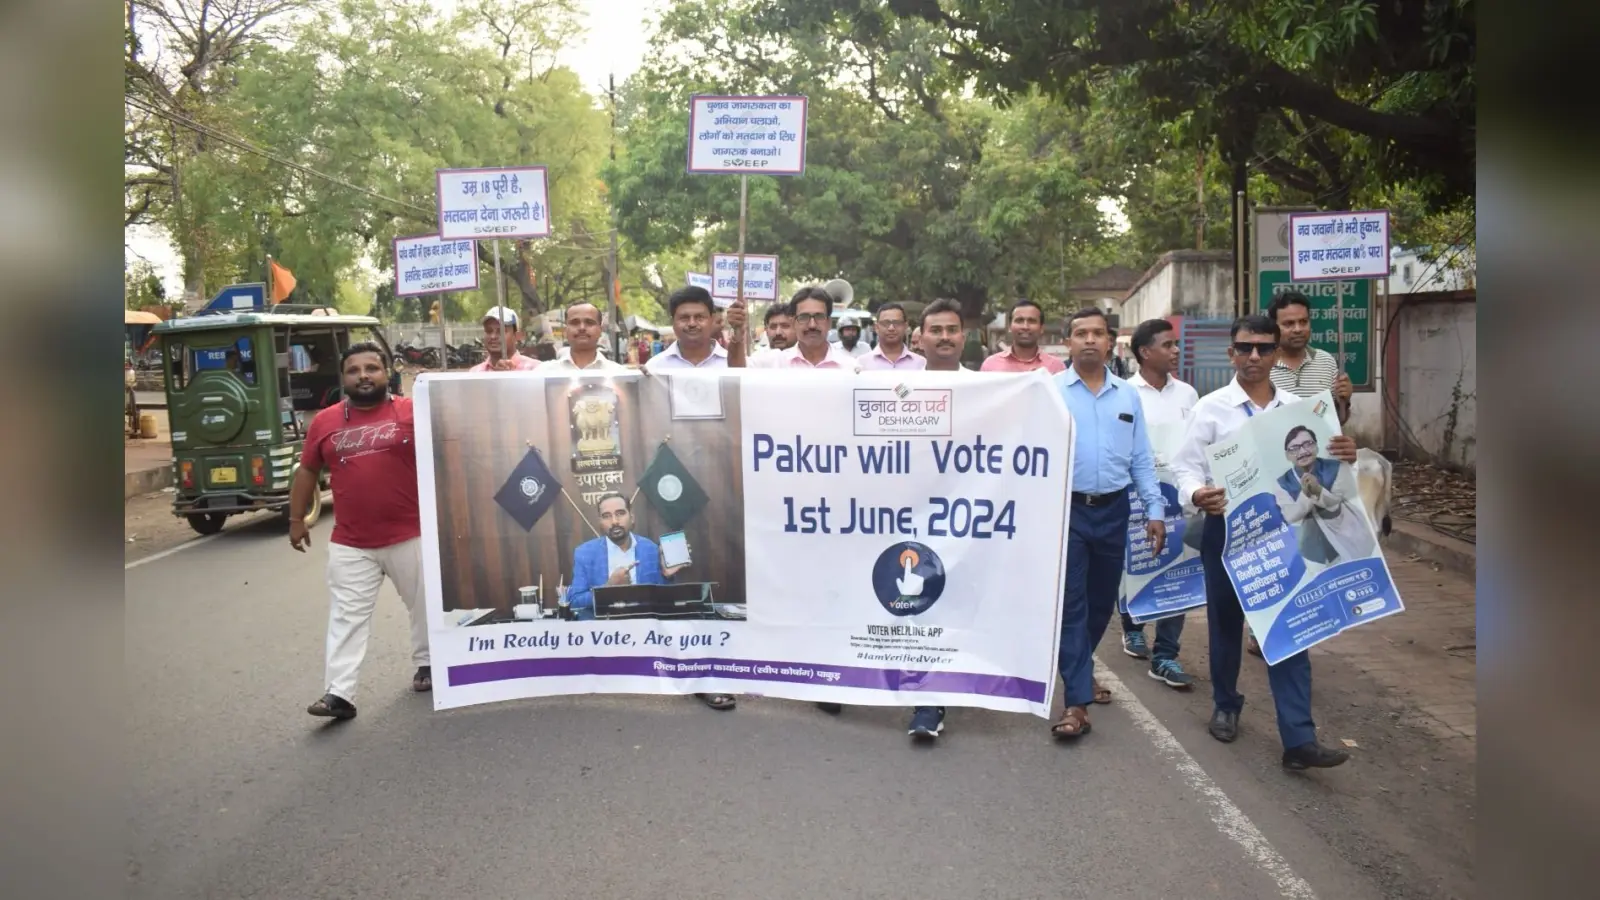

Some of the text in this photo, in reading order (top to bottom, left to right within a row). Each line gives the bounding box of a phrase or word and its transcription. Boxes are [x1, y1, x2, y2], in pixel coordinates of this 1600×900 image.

[707, 102, 729, 113] चुनाव
[779, 102, 792, 110] का
[714, 114, 748, 125] अभियान
[722, 131, 734, 140] को
[736, 132, 765, 141] मतदान
[767, 131, 777, 141] के
[779, 130, 796, 142] लिए
[723, 158, 768, 167] SWEEP
[481, 181, 490, 194] 18
[493, 174, 508, 199] पूरी
[444, 210, 478, 223] मतदान
[480, 205, 498, 221] देना
[501, 202, 529, 220] जरूरी
[1298, 224, 1310, 236] नव
[1336, 218, 1344, 234] ने
[1345, 217, 1358, 234] भरी
[1298, 250, 1310, 264] इस
[1312, 249, 1324, 261] बार
[1326, 248, 1351, 260] मतदान
[1322, 266, 1361, 274] SWEEP
[857, 394, 948, 419] चुनाव का पर्व
[878, 416, 940, 426] DESH KA GARV
[753, 433, 1049, 478] Pakur will Vote on
[573, 470, 624, 491] उपायुक्त
[783, 497, 1016, 540] 1st June, 2024
[867, 625, 889, 636] VOTER
[927, 628, 944, 638] APP
[468, 630, 731, 652] I'm Ready to Vote, Are you ?
[856, 651, 954, 664] #IamVerifiedVoter
[653, 661, 675, 671] जिला
[713, 662, 750, 673] कार्यालय
